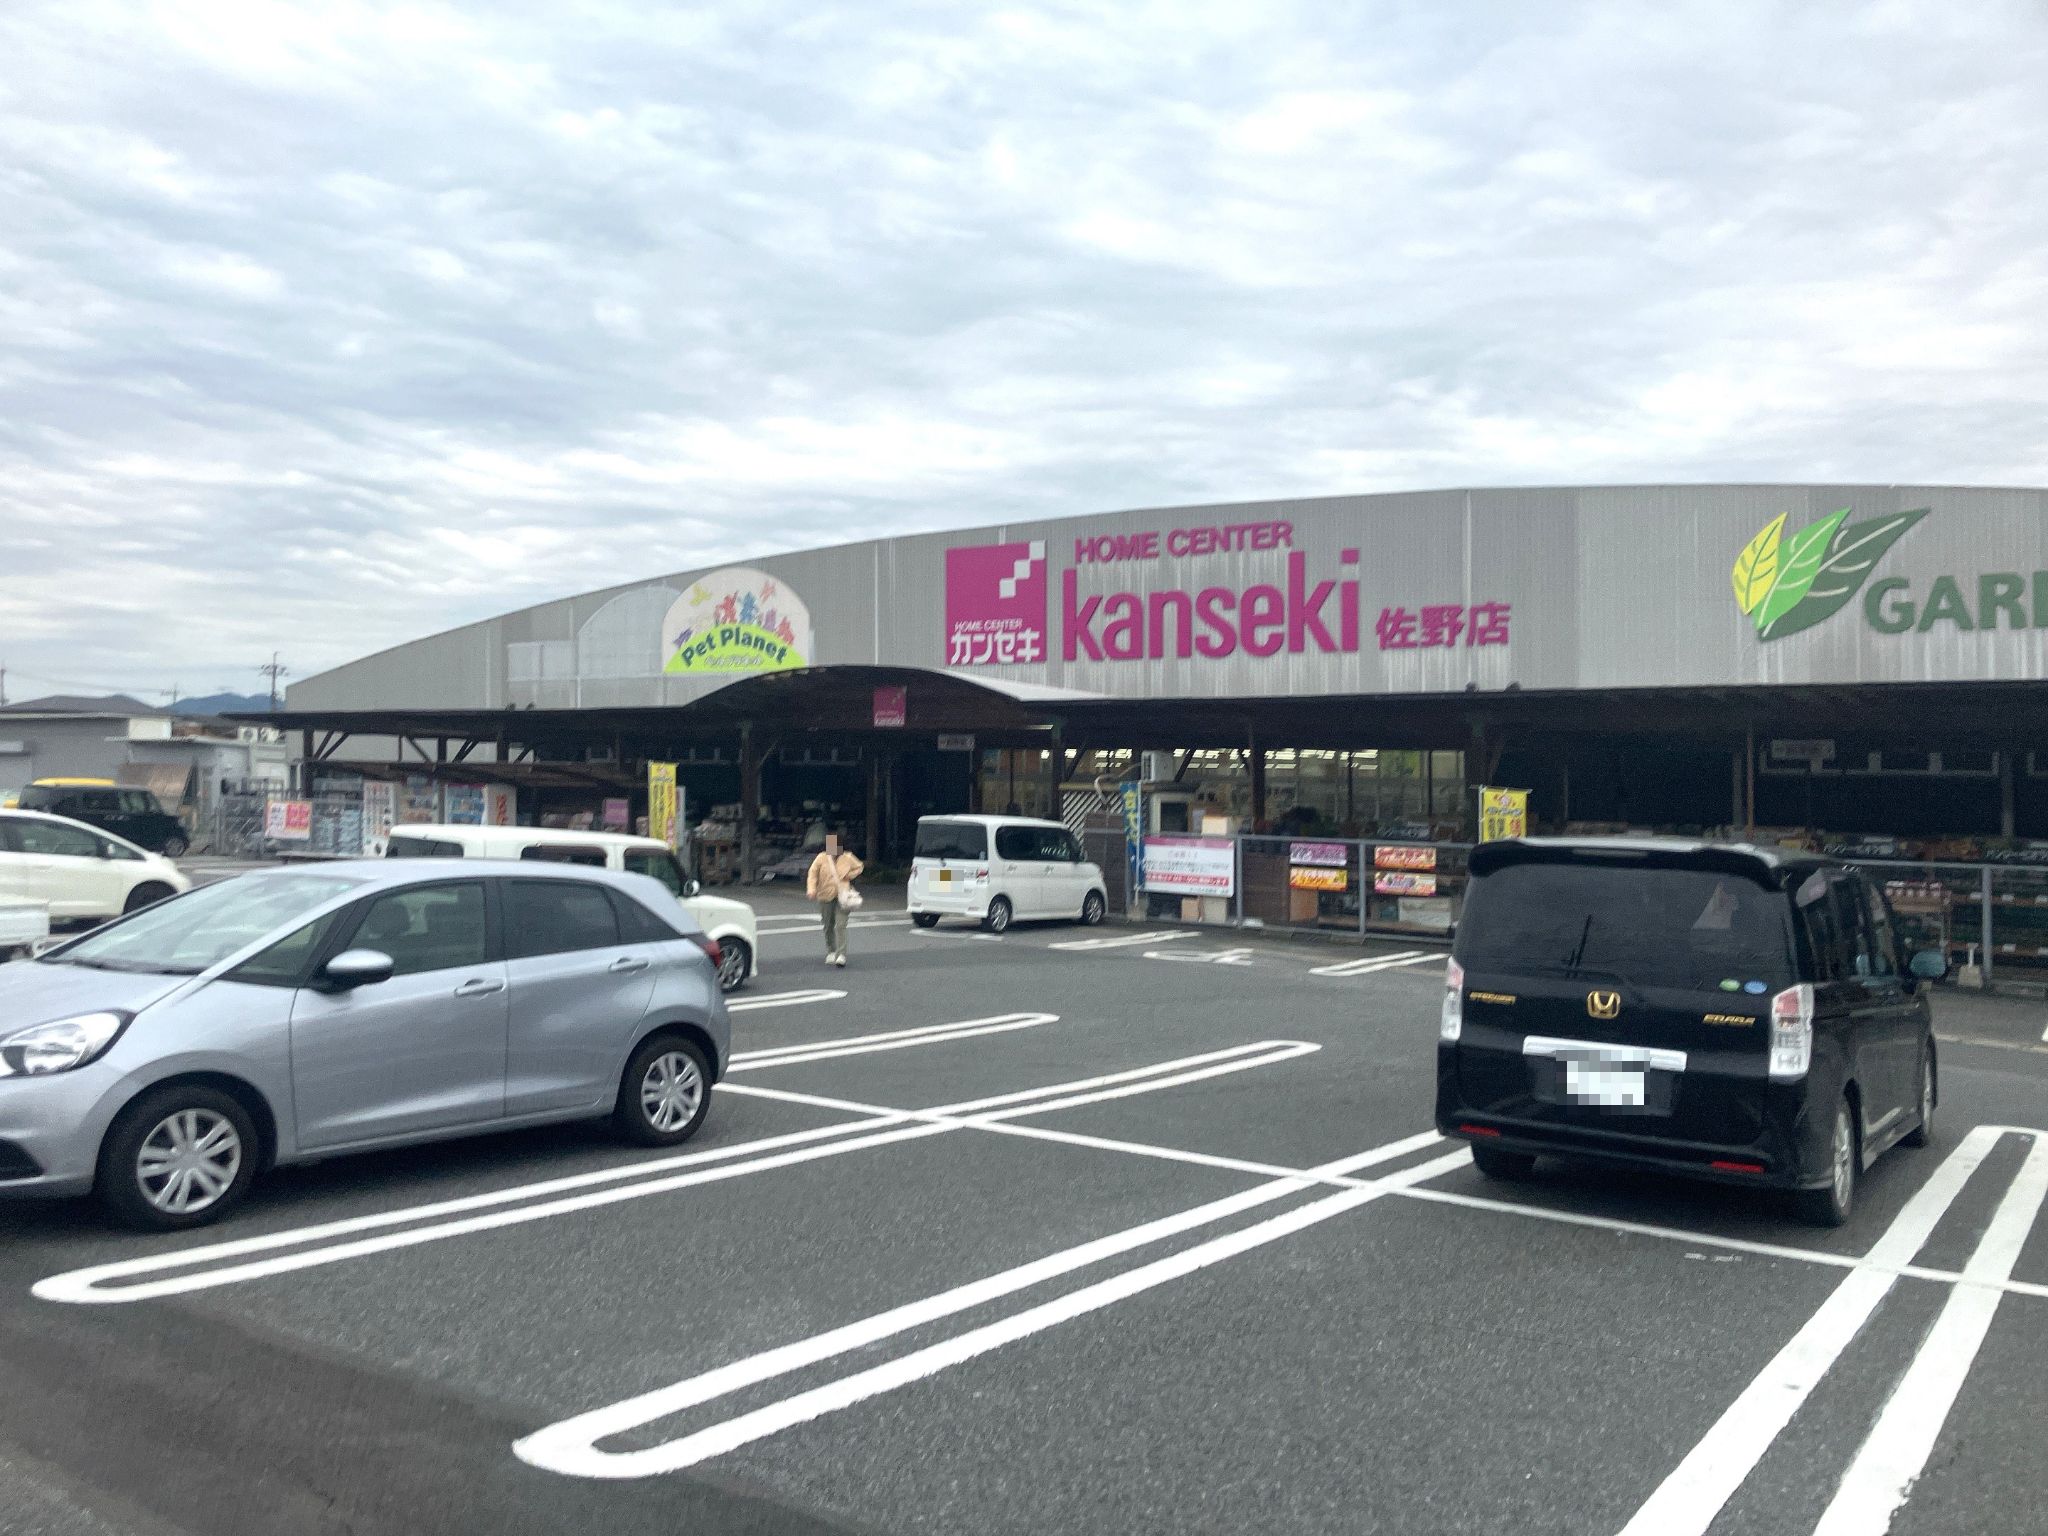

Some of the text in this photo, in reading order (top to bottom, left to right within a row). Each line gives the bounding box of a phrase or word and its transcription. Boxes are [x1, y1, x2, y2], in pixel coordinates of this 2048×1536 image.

[1075, 520, 1294, 564] HOME CENTER
[955, 617, 1023, 632] HOME CENTER
[1062, 548, 1361, 661] kanseki
[1375, 602, 1512, 650] 佐野店
[681, 626, 789, 668] Pet Planet
[951, 627, 1040, 667] カンセキ
